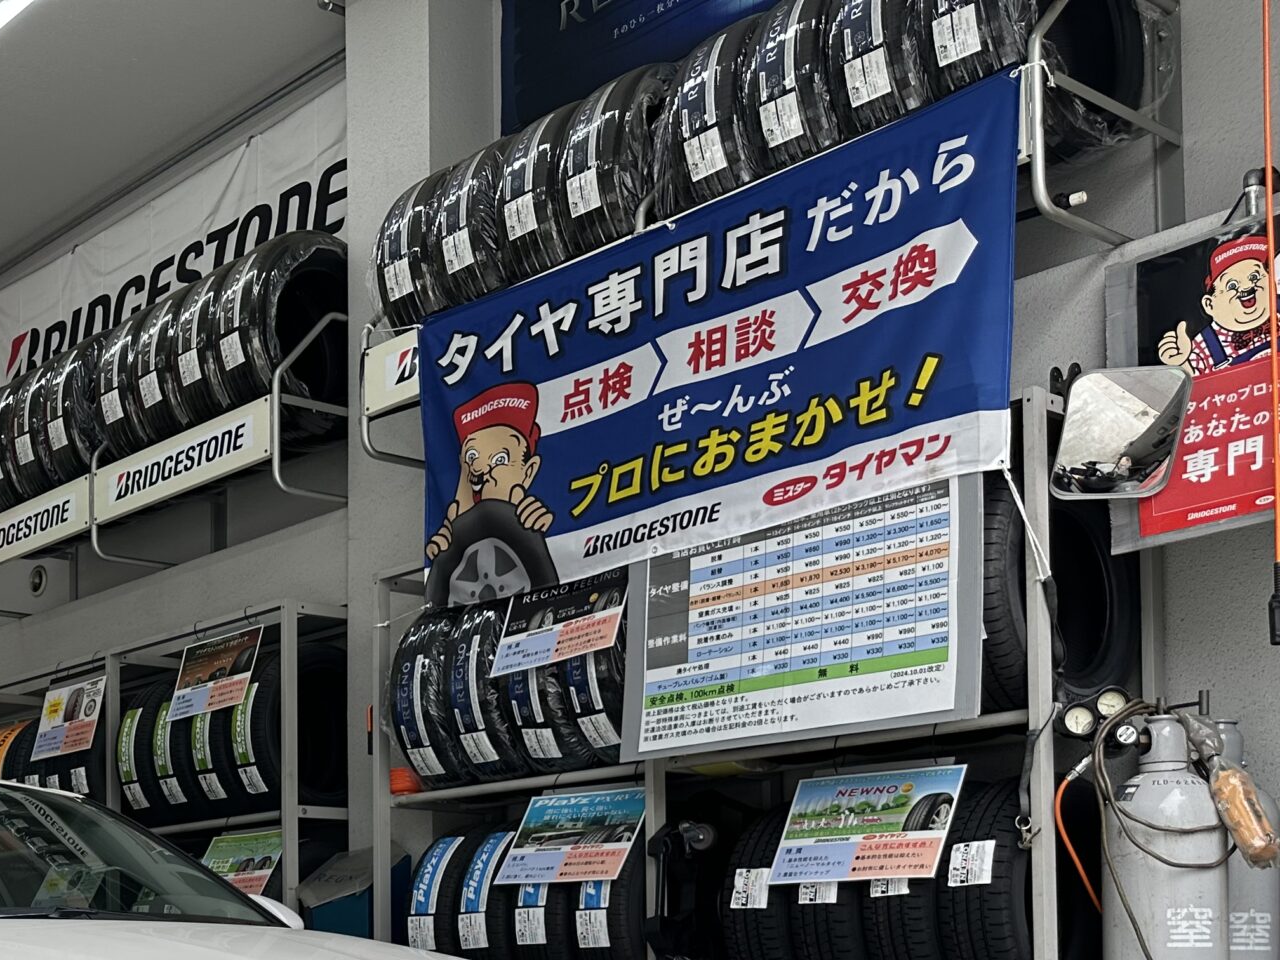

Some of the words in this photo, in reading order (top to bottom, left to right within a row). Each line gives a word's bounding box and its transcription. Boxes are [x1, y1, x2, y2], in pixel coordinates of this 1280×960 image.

[1214, 243, 1268, 264] BRIDGESTONE
[561, 360, 633, 423] 点検
[687, 308, 777, 374] 相談
[841, 242, 939, 324] 交換
[460, 397, 531, 424] BRIDGESTONE
[114, 422, 246, 502] BRIDGESTONE
[773, 482, 813, 503] ミスター
[823, 432, 951, 490] タイヤマン
[1182, 435, 1264, 484] 専門
[583, 501, 722, 559] BRIDGESTONE
[1187, 503, 1237, 521] BRIDGESTONE
[523, 586, 569, 604] REGNO
[573, 569, 621, 591] FEELING
[400, 662, 412, 721] REGNO
[455, 643, 467, 703] REGNO
[835, 785, 899, 797] NEWNO
[417, 856, 439, 902] Playz
[467, 852, 489, 900] Playz
